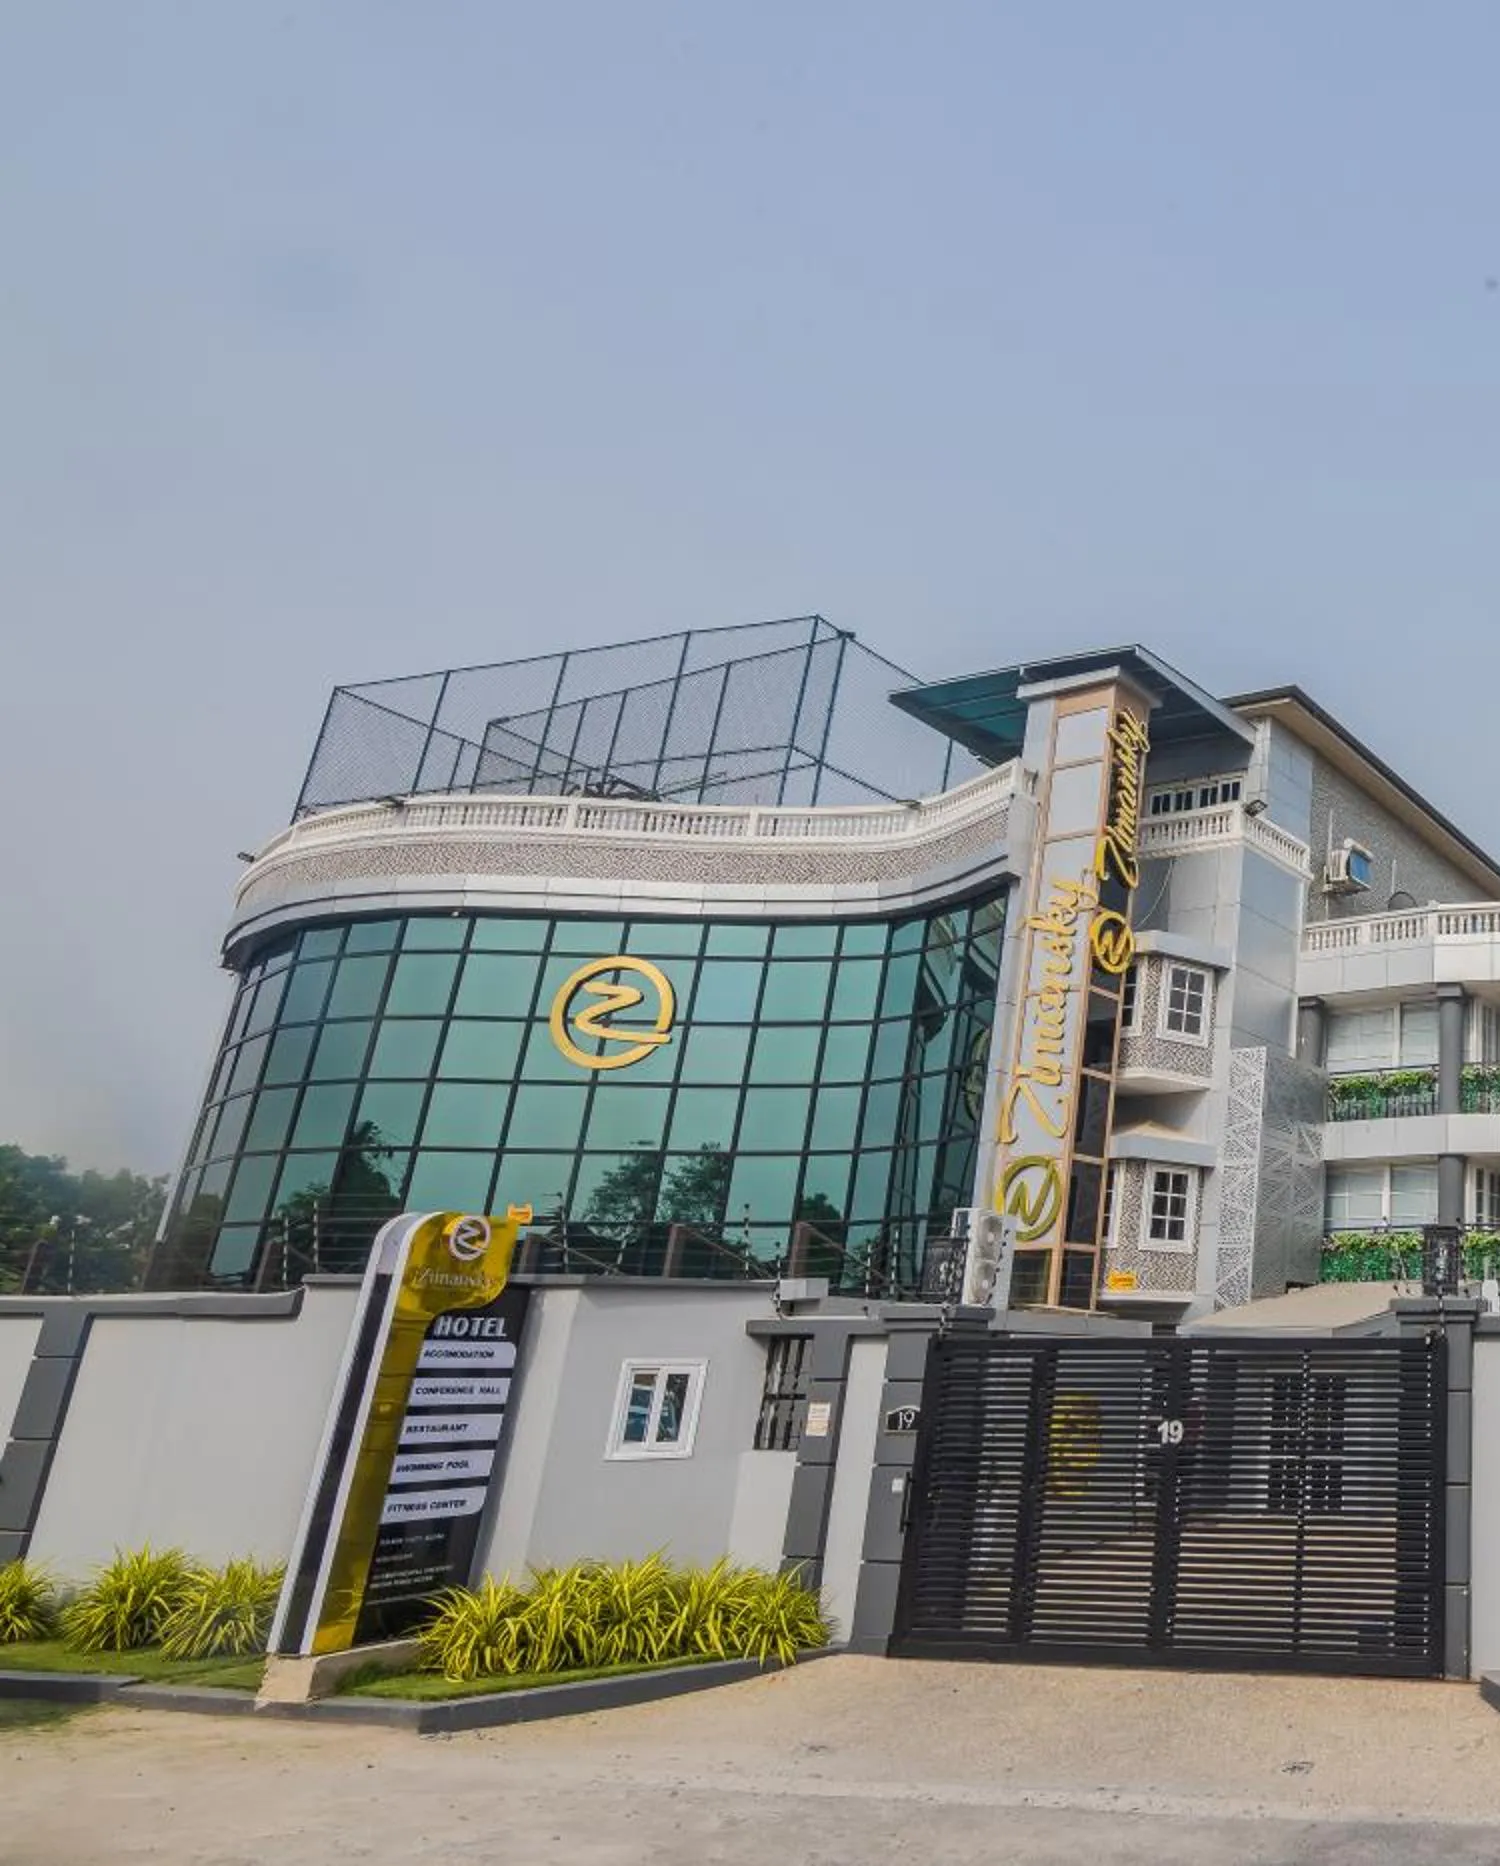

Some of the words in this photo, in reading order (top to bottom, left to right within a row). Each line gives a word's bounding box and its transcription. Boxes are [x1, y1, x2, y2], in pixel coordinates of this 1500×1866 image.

[998, 868, 1099, 1144] Zimansky
[410, 1266, 500, 1293] Zimans
[434, 1315, 507, 1337] HOTEL
[415, 1386, 474, 1395] CONFERENCE
[478, 1386, 500, 1395] HALL
[405, 1423, 469, 1433] RESTAURANT
[1157, 1420, 1184, 1444] 19
[446, 1460, 470, 1470] POOL
[387, 1502, 428, 1513] FITNESS
[429, 1499, 468, 1510] CENTER
